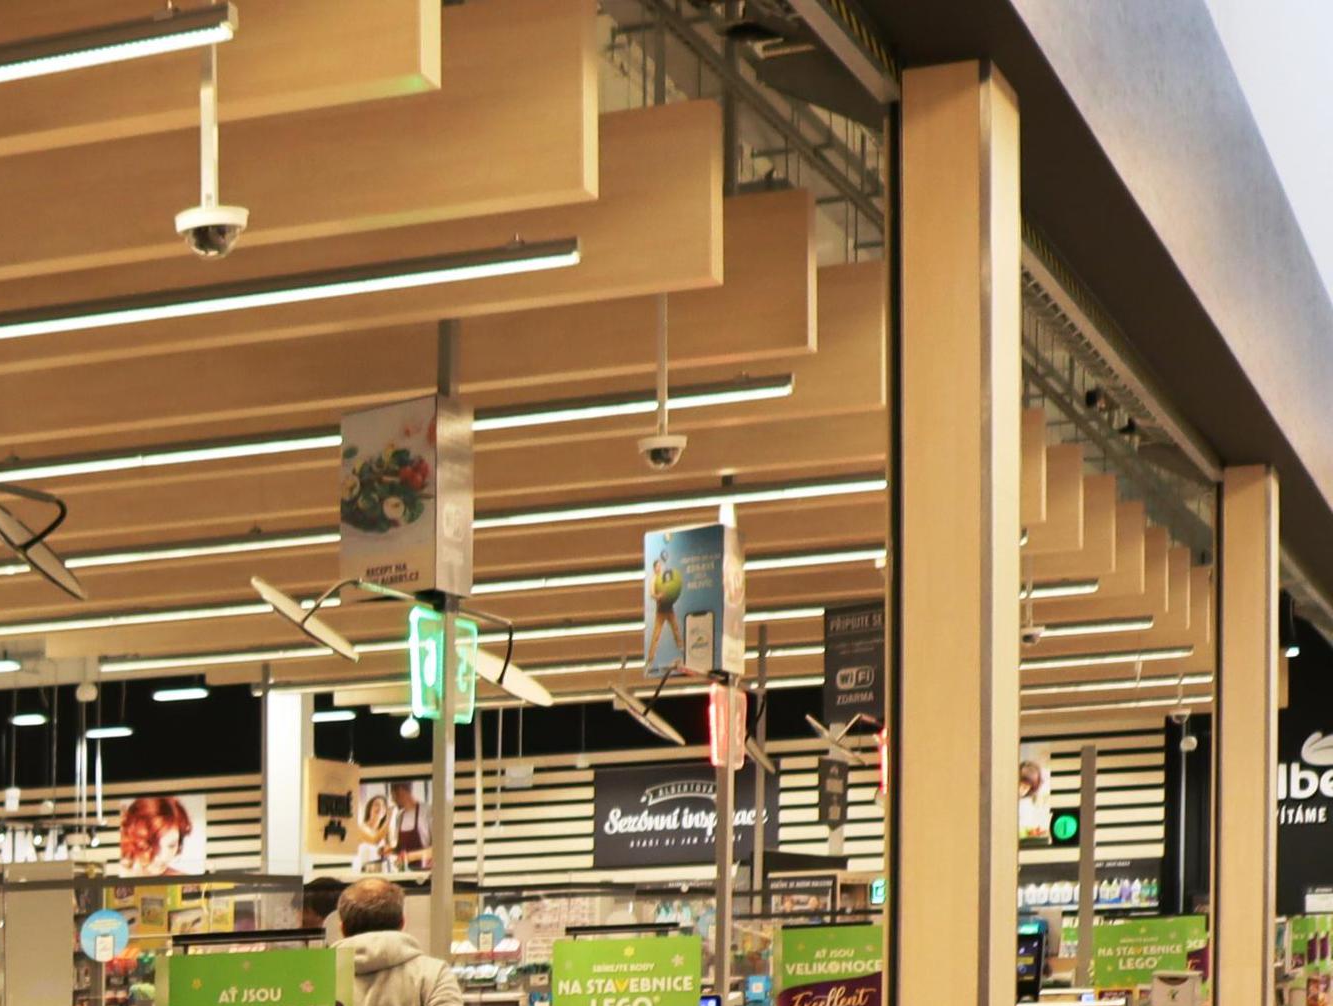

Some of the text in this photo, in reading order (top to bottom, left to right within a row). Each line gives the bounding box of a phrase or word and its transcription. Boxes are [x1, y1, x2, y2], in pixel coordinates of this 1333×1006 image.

[1276, 804, 1327, 825] ÍTÁME
[630, 962, 655, 973] BODY
[785, 959, 883, 976] VELIKONOCE
[1118, 957, 1158, 971] LEGO
[558, 975, 694, 996] NA STAVEBNICE
[218, 986, 282, 1004] AŤ JSOU
